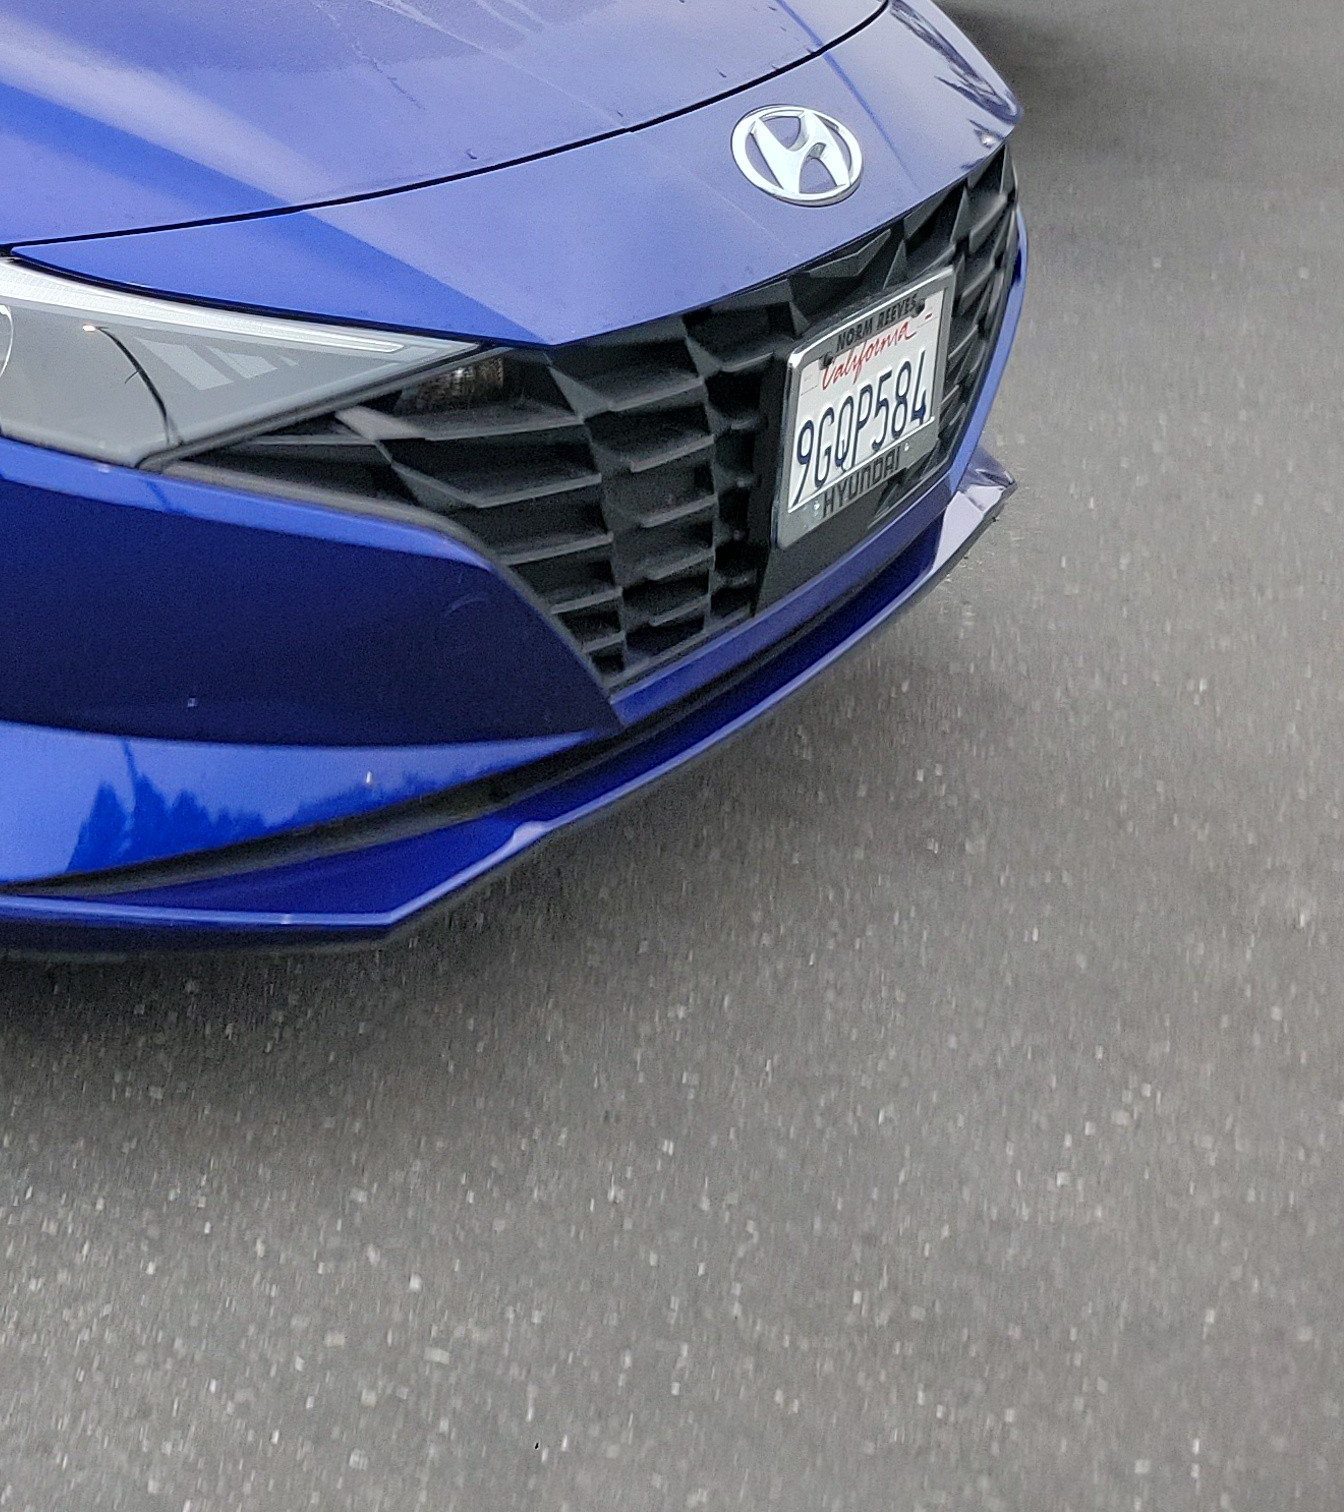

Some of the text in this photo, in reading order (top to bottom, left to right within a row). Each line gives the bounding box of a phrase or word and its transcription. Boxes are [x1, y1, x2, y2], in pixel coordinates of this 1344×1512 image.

[822, 321, 918, 390] California
[835, 316, 873, 353] NORM
[792, 349, 927, 506] 9GQP584
[823, 447, 901, 517] HYUNDAI
